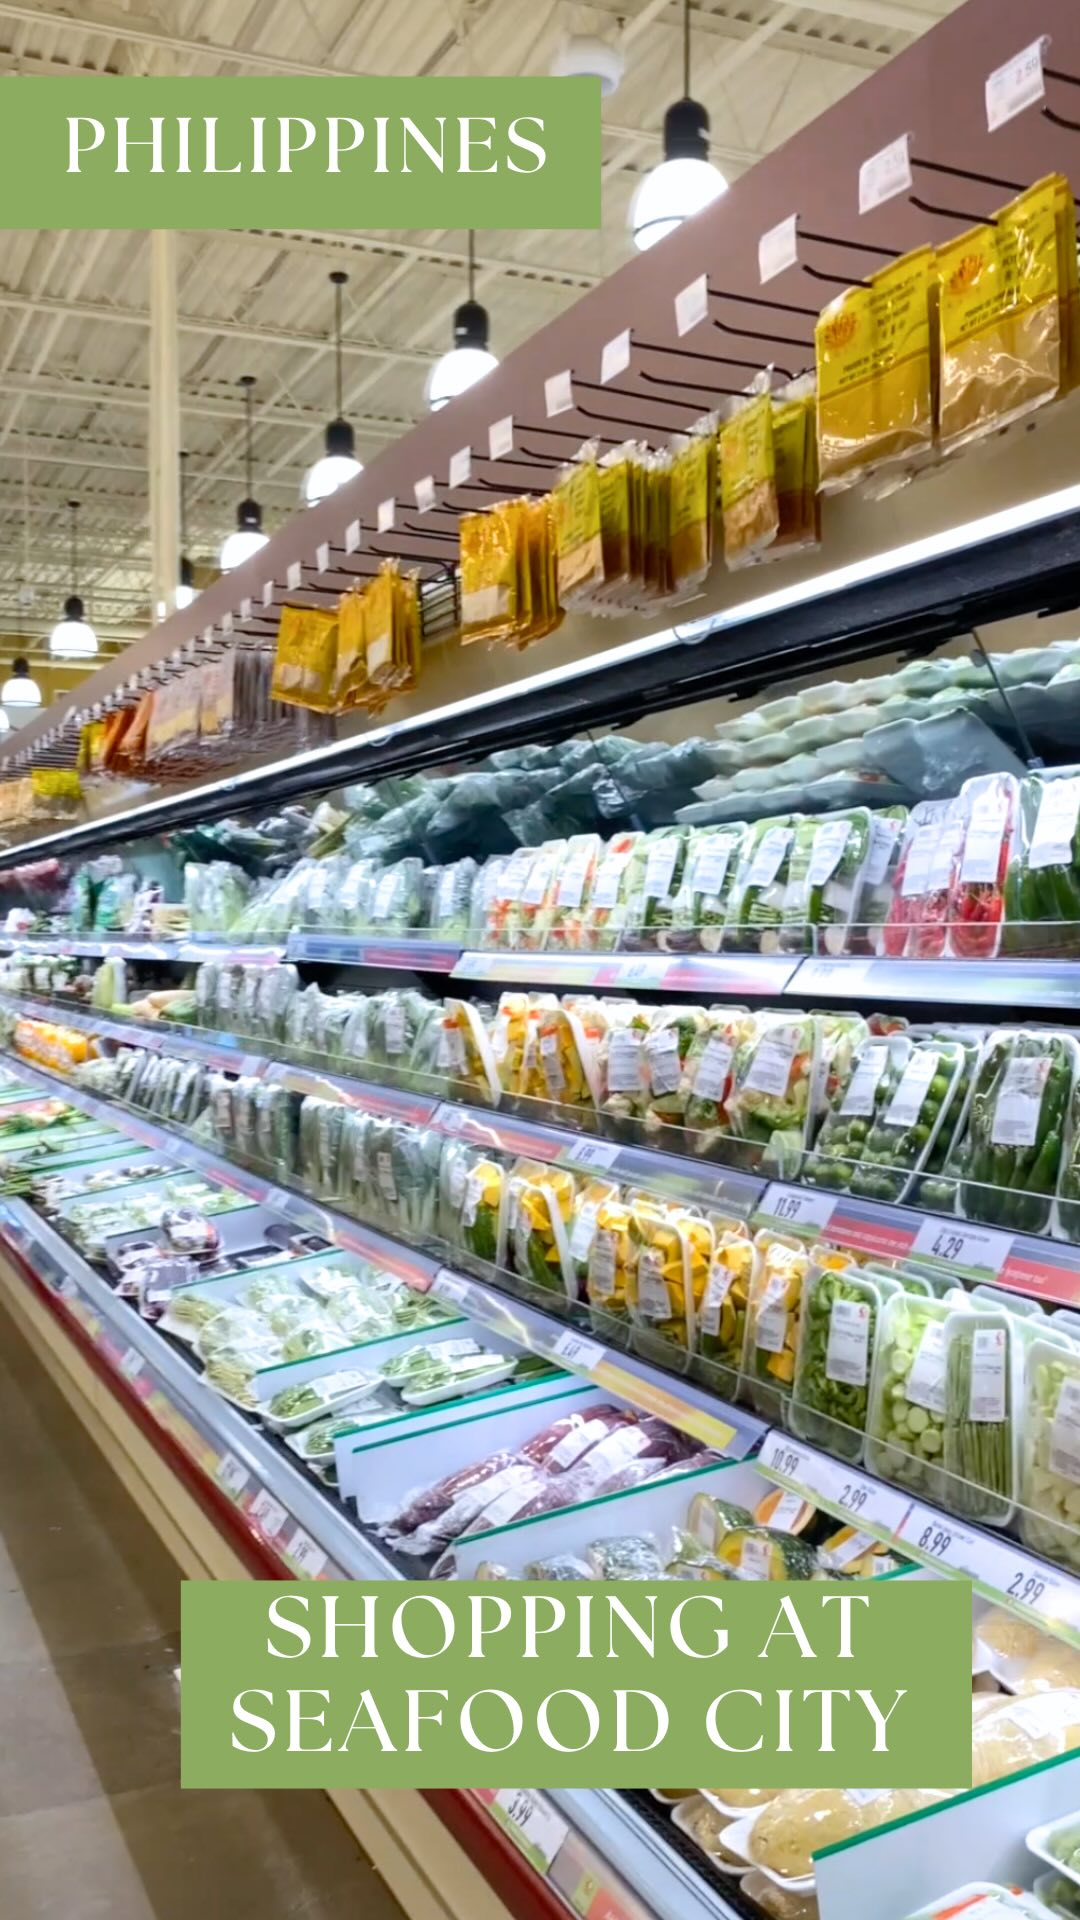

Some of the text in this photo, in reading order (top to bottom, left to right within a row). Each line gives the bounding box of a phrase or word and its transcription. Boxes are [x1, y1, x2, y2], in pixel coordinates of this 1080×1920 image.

[773, 1197, 802, 1219] 11.99
[931, 1234, 964, 1260] 4.29
[770, 1447, 800, 1476] 10.99
[838, 1484, 868, 1512] 2.99
[918, 1526, 952, 1556] 8.99
[1006, 1572, 1045, 1604] 2.99
[508, 1791, 534, 1827] 3.99
